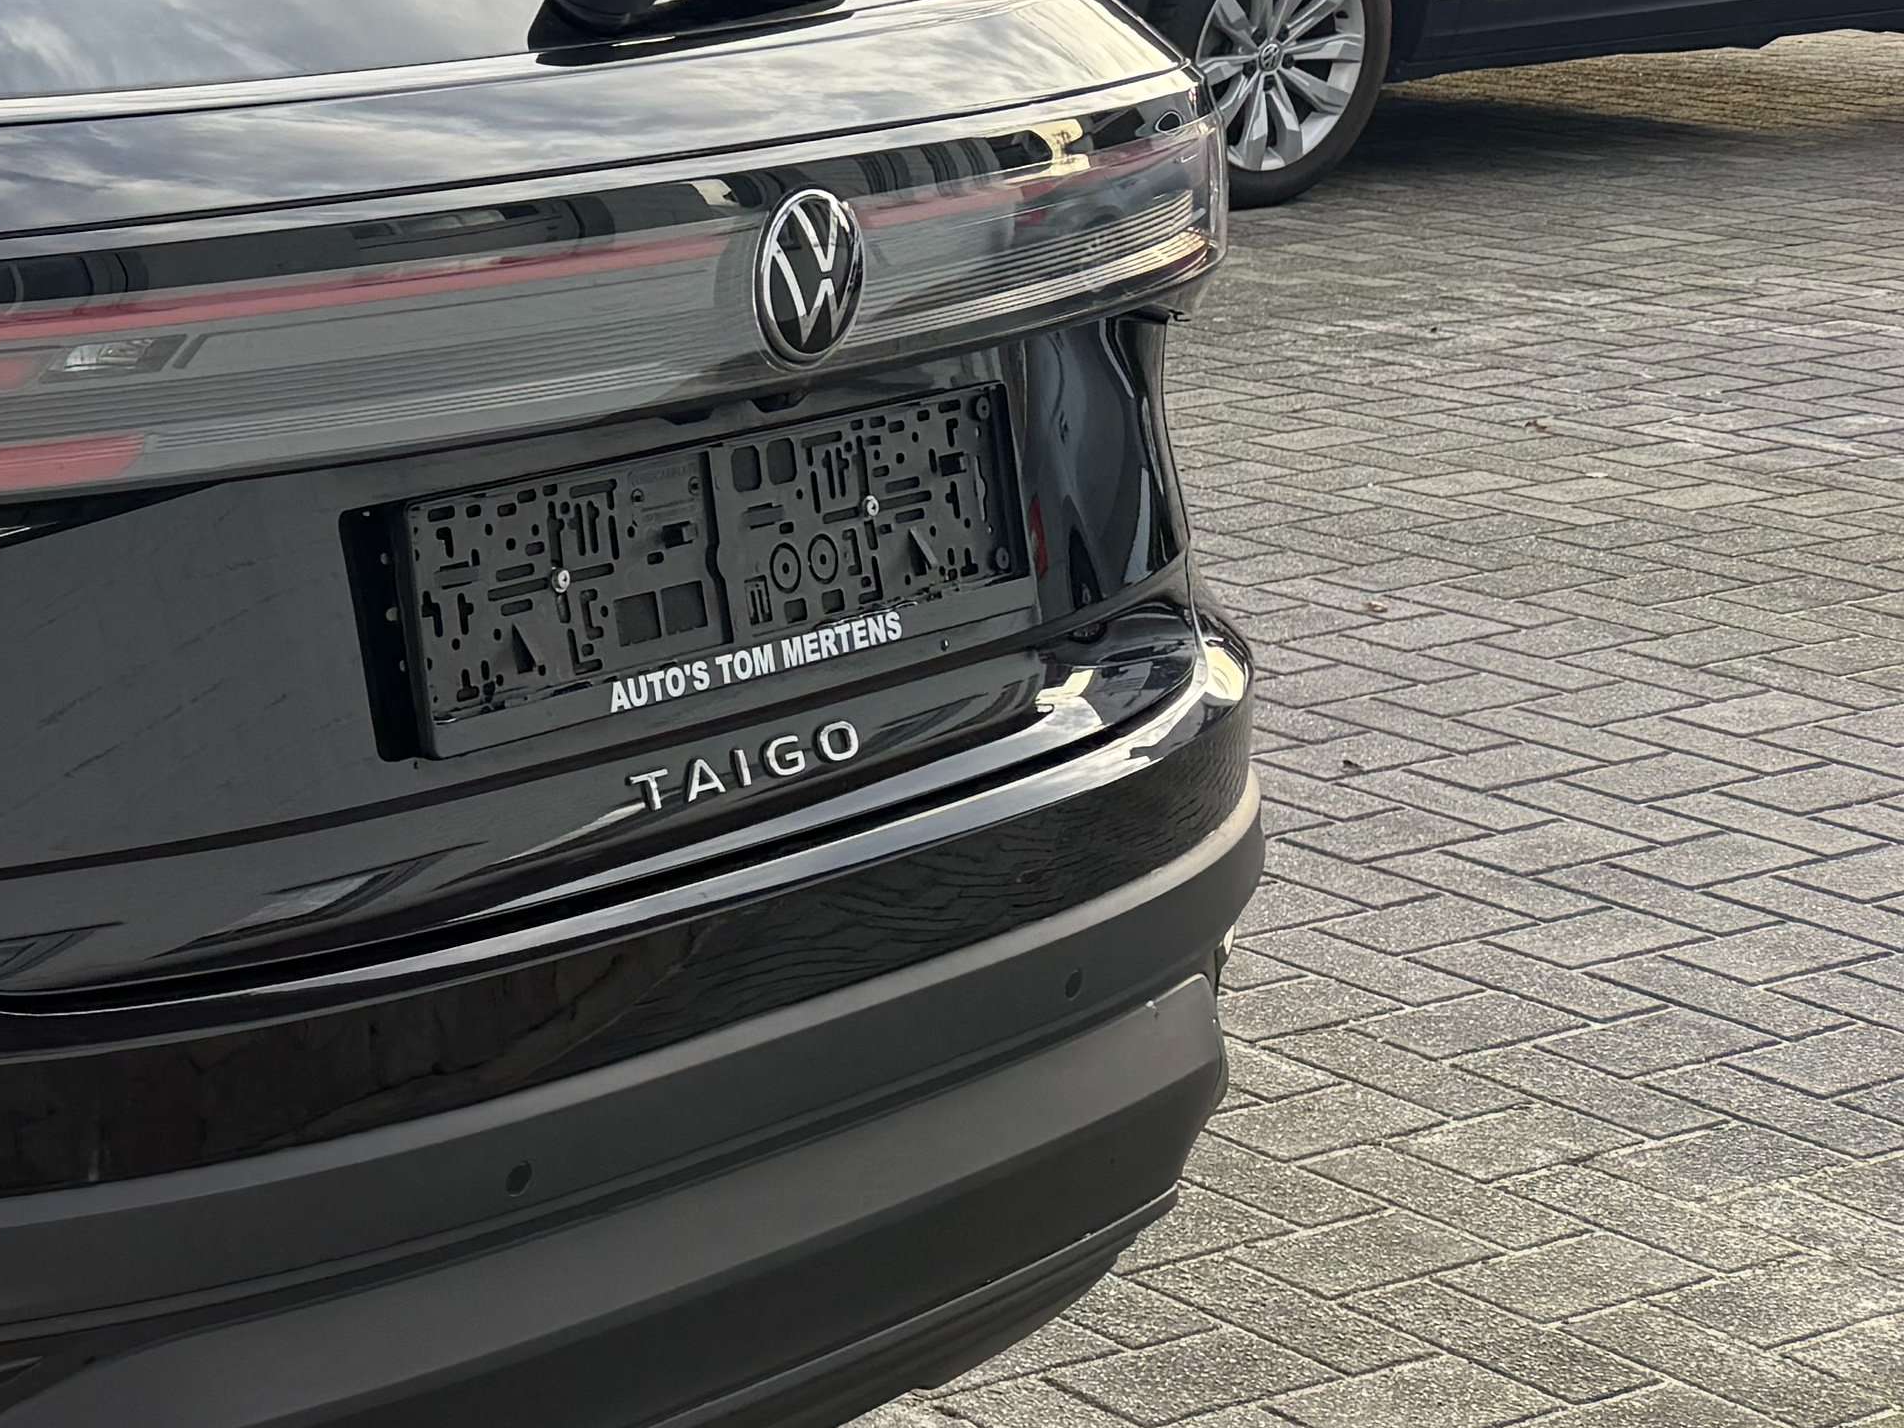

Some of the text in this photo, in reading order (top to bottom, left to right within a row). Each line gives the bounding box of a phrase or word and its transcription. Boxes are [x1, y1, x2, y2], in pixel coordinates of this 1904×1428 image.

[610, 611, 903, 713] AUTO'S TOM MERTENS
[627, 721, 861, 812] TAIGO
